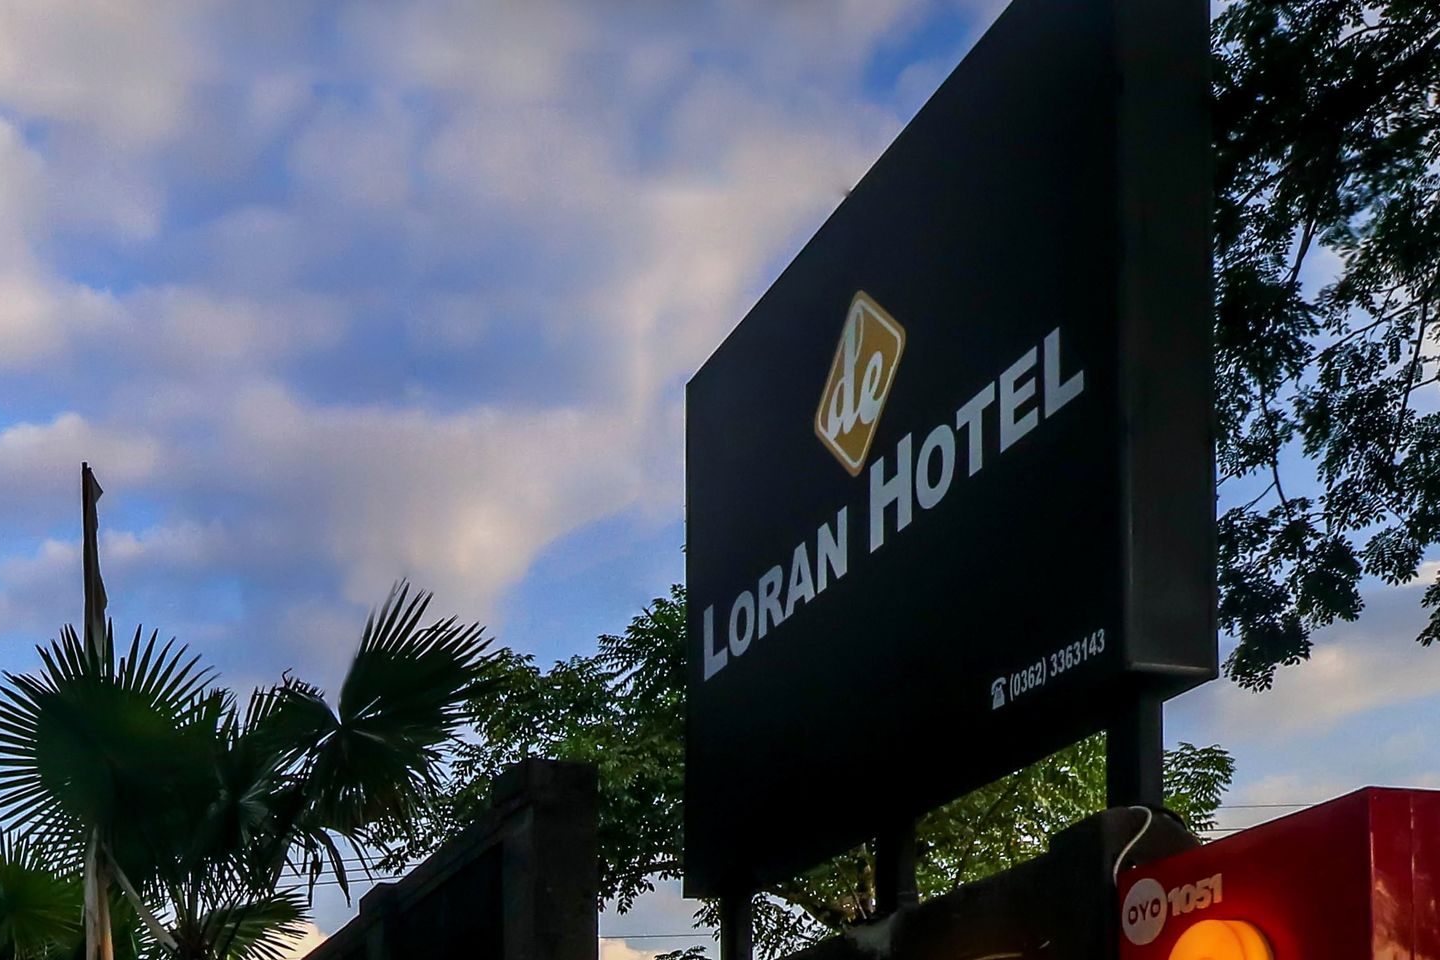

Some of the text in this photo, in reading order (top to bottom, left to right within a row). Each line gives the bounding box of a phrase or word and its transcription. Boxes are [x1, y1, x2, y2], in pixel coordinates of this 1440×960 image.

[826, 303, 885, 441] de
[702, 326, 1085, 682] LORAN HOTEL
[1009, 628, 1105, 701] (0362) 3363143
[1127, 872, 1223, 926] OYO 1051
